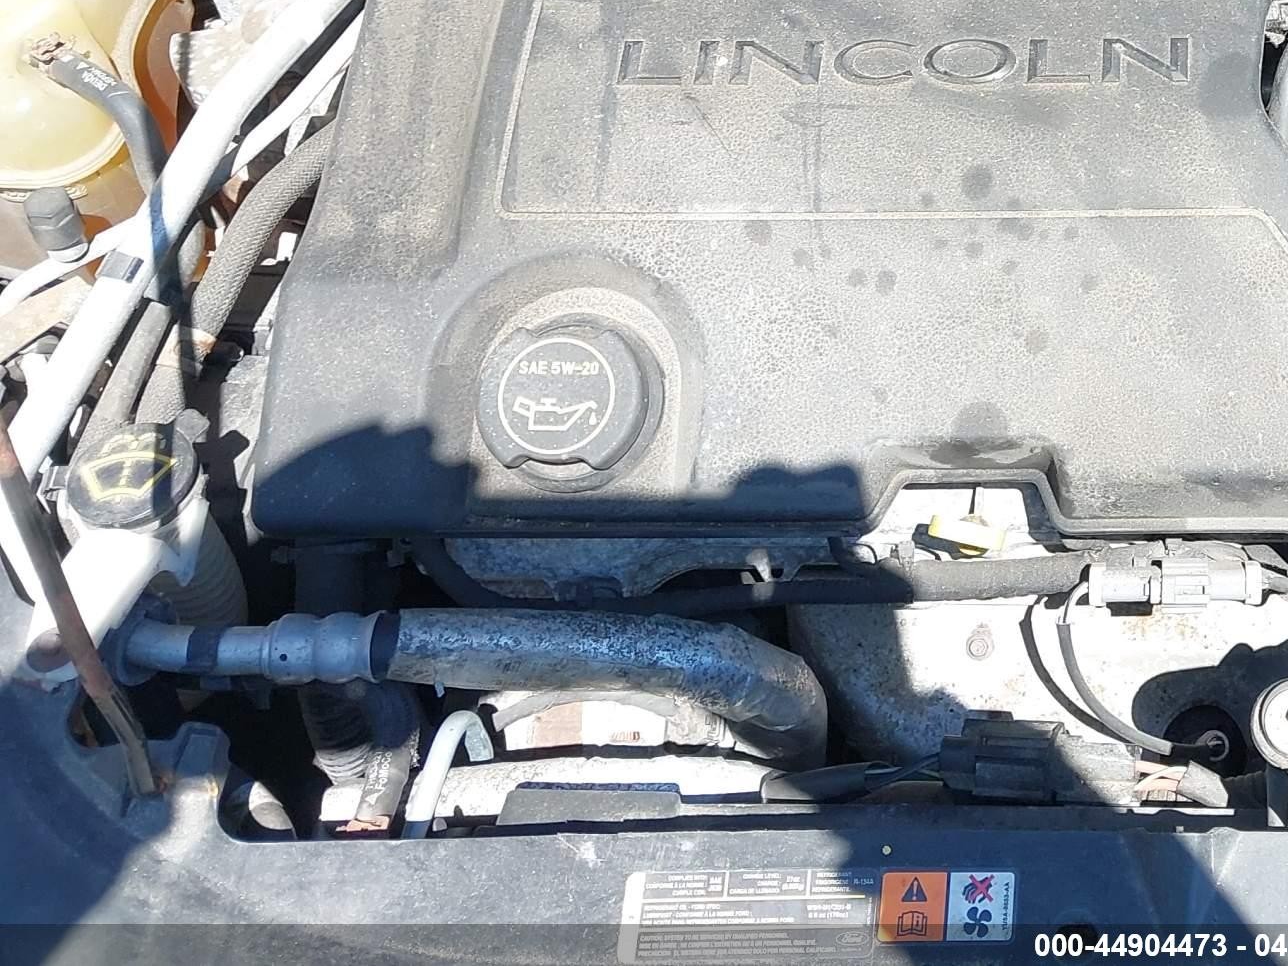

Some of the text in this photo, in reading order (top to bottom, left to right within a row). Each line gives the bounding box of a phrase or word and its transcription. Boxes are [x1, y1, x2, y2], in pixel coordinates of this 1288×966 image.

[617, 37, 1191, 85] LINCOLN
[518, 360, 600, 376] SAE 5W-20
[375, 751, 393, 790] FoMoCo
